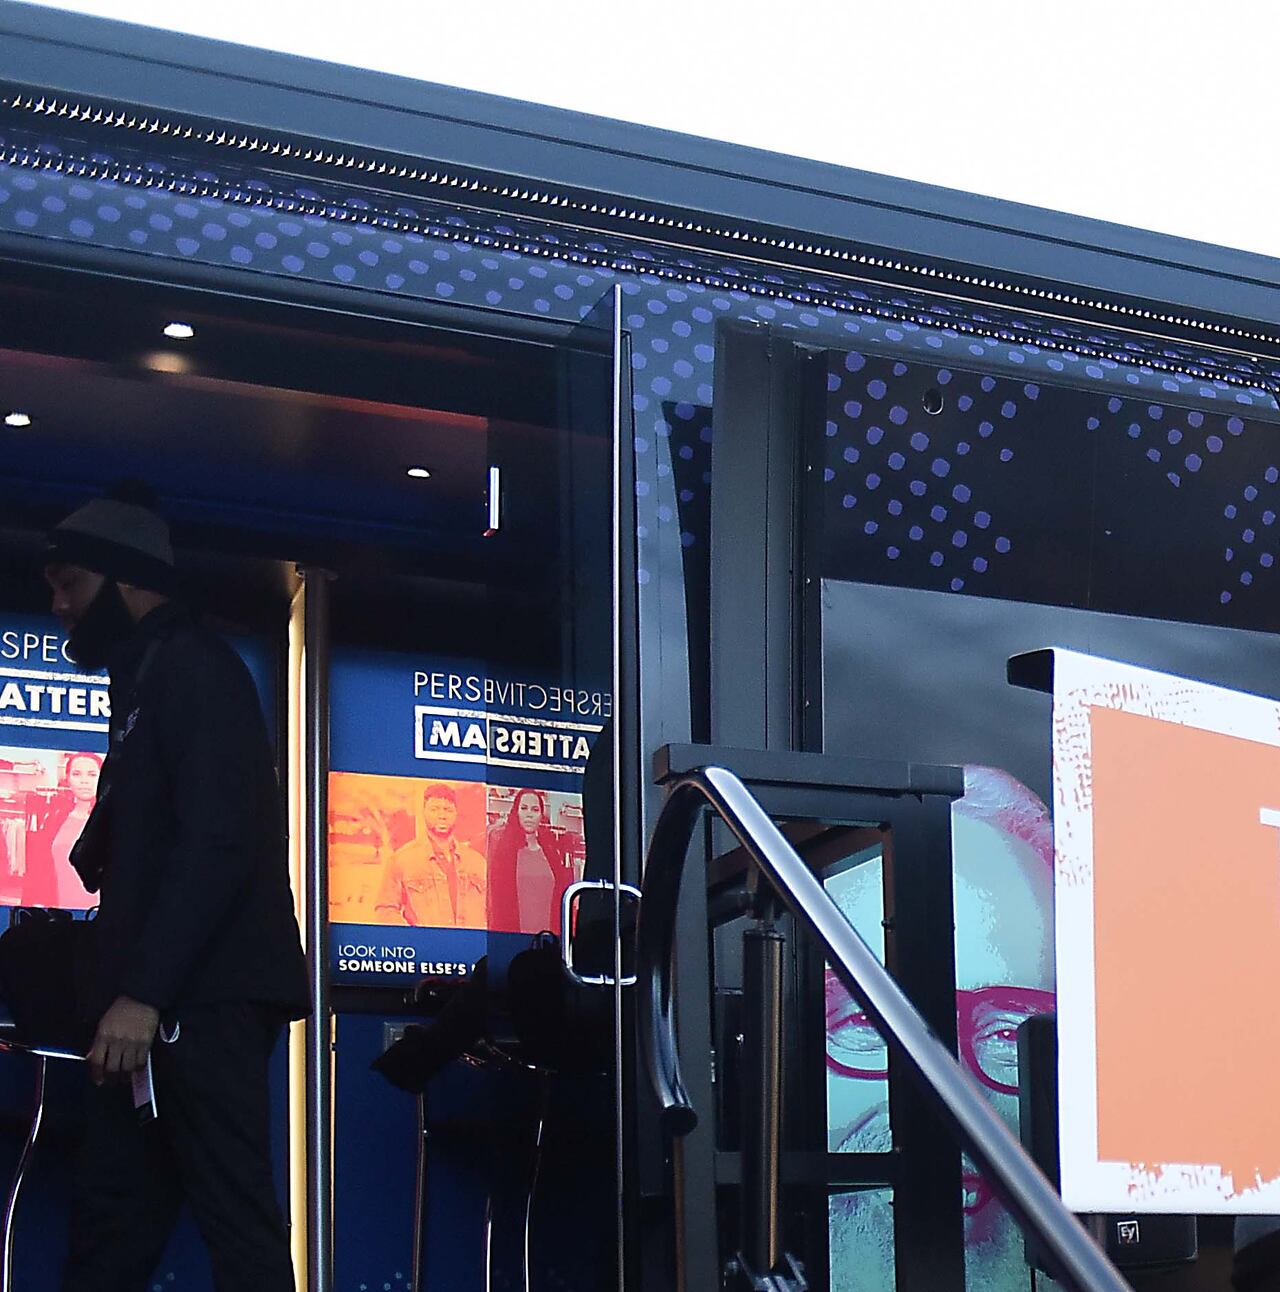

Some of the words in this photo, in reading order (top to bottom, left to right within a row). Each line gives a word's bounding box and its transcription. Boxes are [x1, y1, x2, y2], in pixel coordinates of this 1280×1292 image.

[0, 682, 112, 717] ATTER
[338, 945, 377, 958] LOOK
[381, 946, 416, 959] INTO
[338, 960, 416, 974] SOMEONE
[420, 962, 467, 975] ELSE'S
